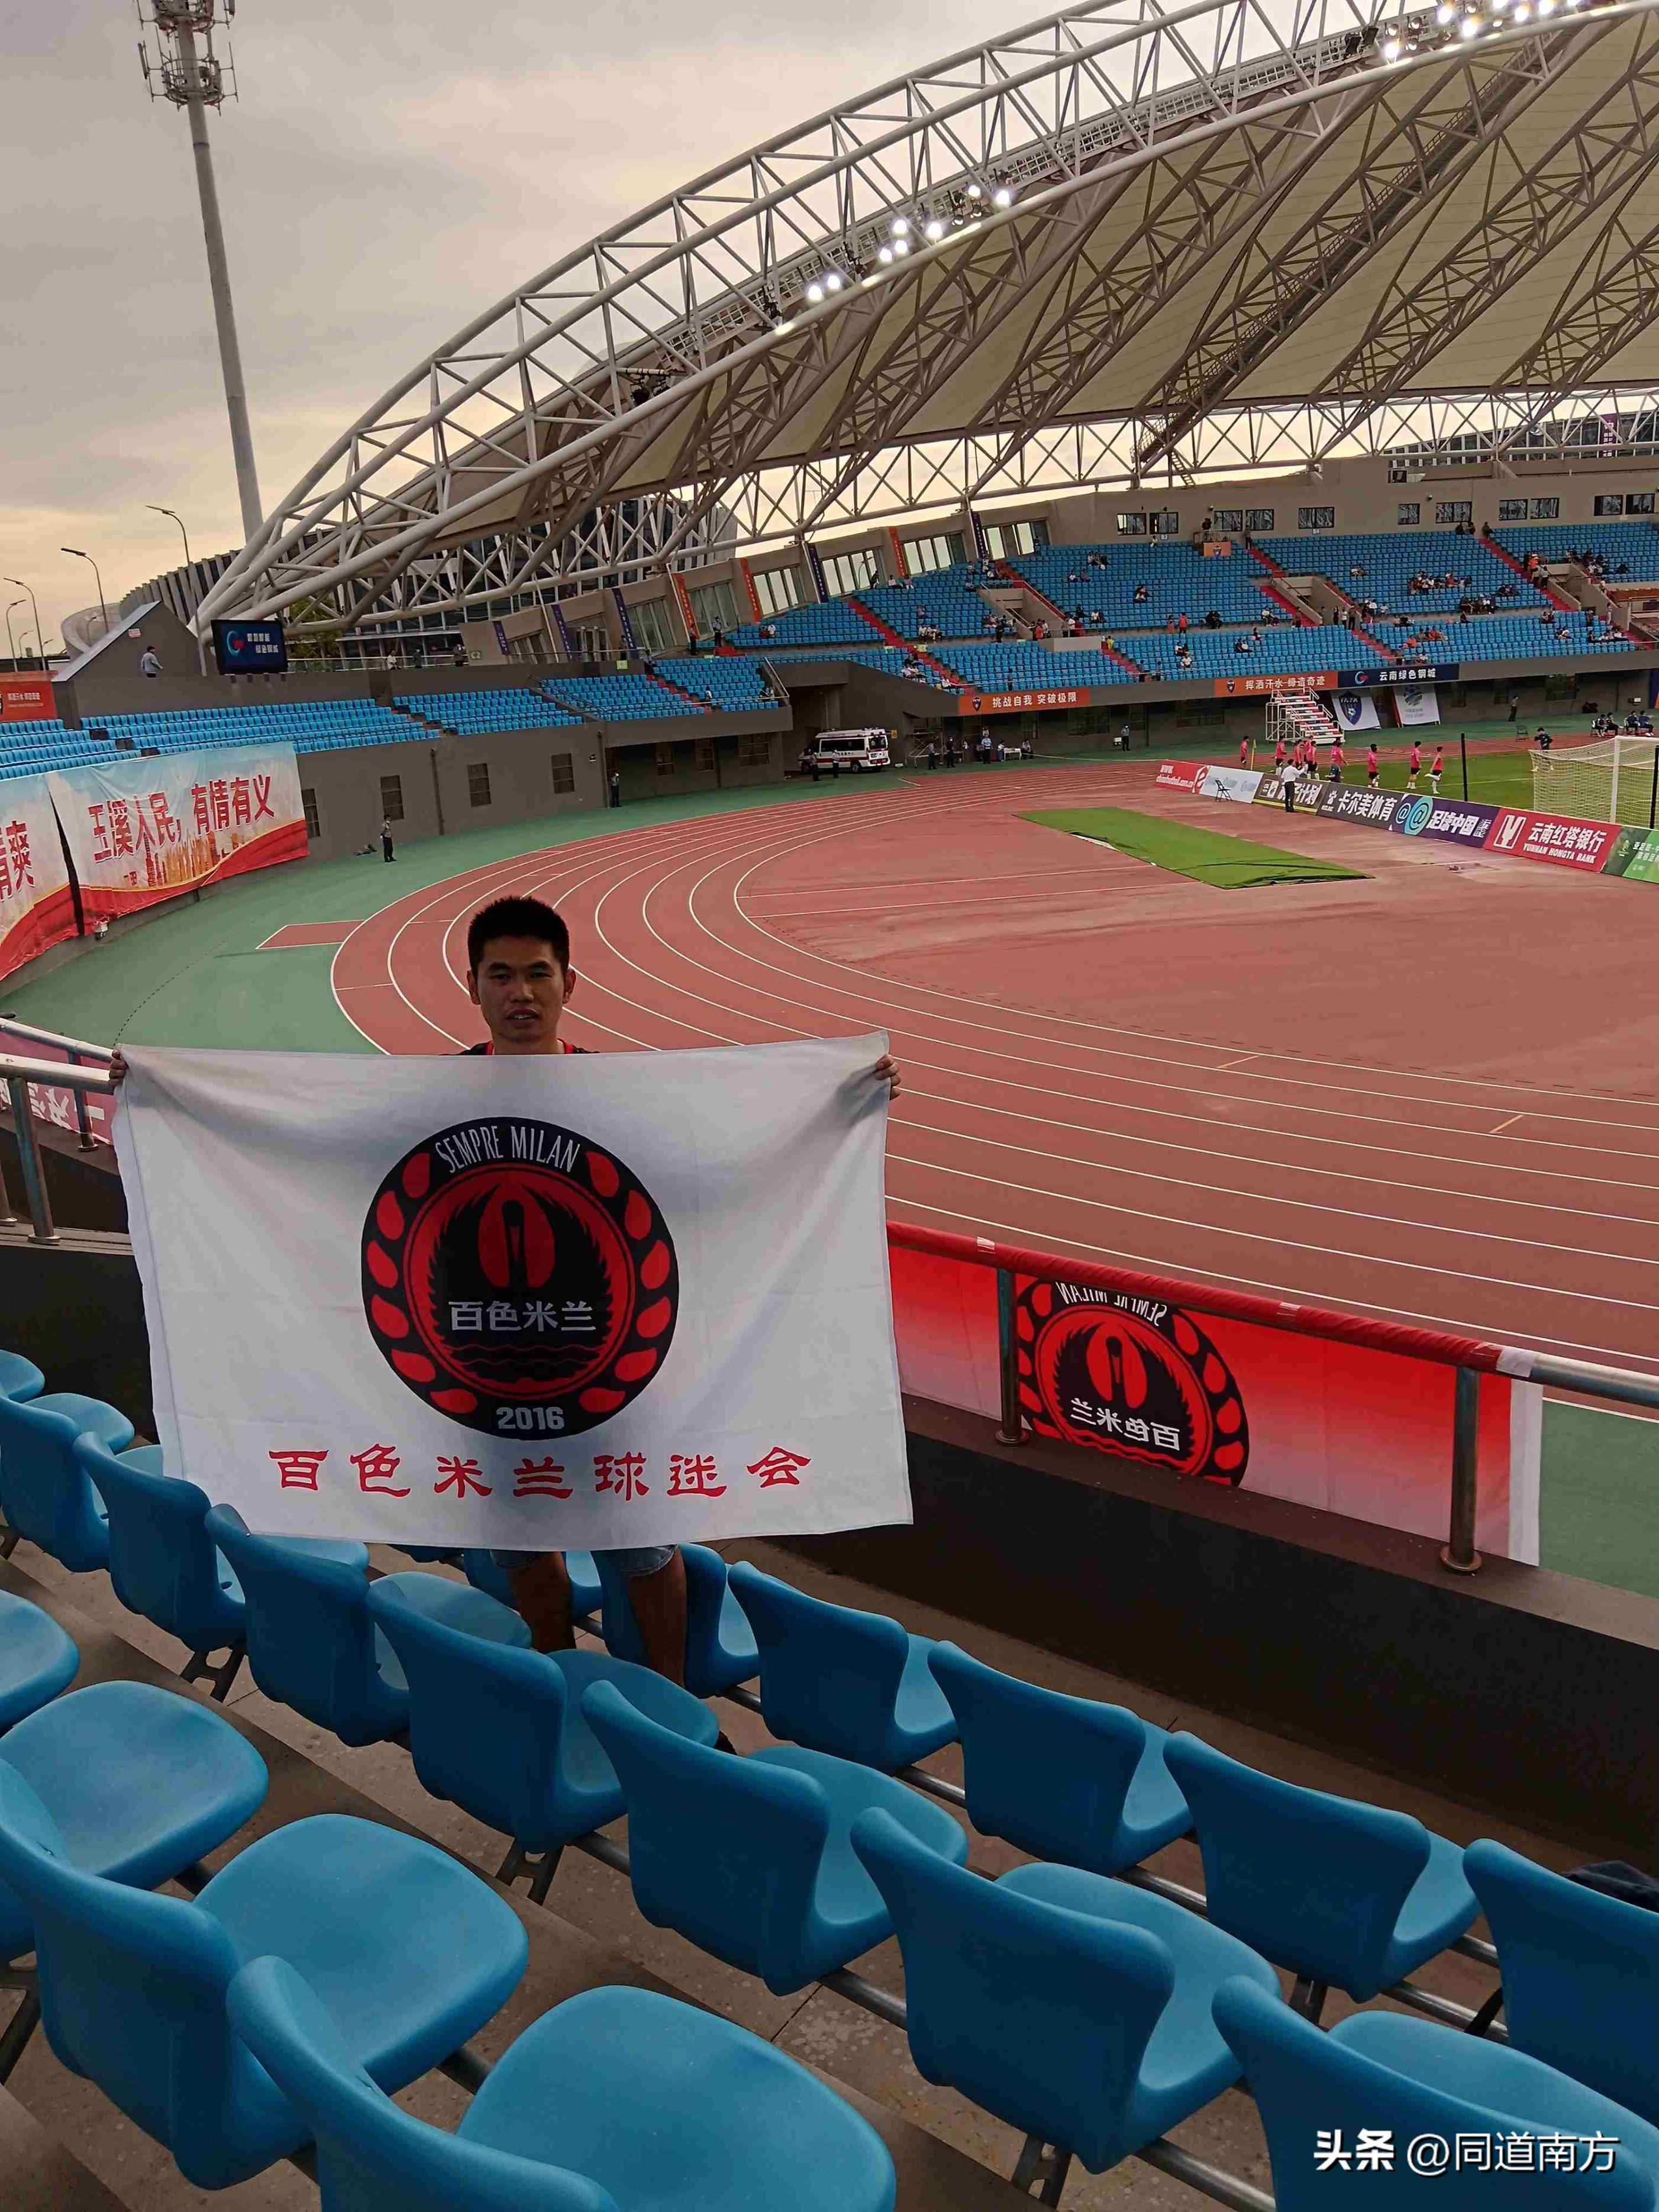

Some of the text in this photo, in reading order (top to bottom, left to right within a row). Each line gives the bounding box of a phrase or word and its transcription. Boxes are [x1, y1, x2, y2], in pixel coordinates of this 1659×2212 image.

[1245, 676, 1325, 690] 挥洒汗水 缔造奇迹
[1379, 669, 1436, 681] 云南绿色钢城
[992, 692, 1077, 708] 挑战自我 突破极限
[1337, 790, 1397, 821] 卡尔美体育
[1426, 809, 1480, 836] 足球中国
[1528, 822, 1607, 852] 云南红塔银行
[1523, 843, 1597, 864] YUNNAN HONGTA BANK
[435, 1125, 580, 1173] SEMPRE MILAN
[448, 1300, 596, 1332] 百色米兰
[496, 1406, 565, 1430] 2016
[268, 1443, 812, 1501] 百色米兰球迷会
